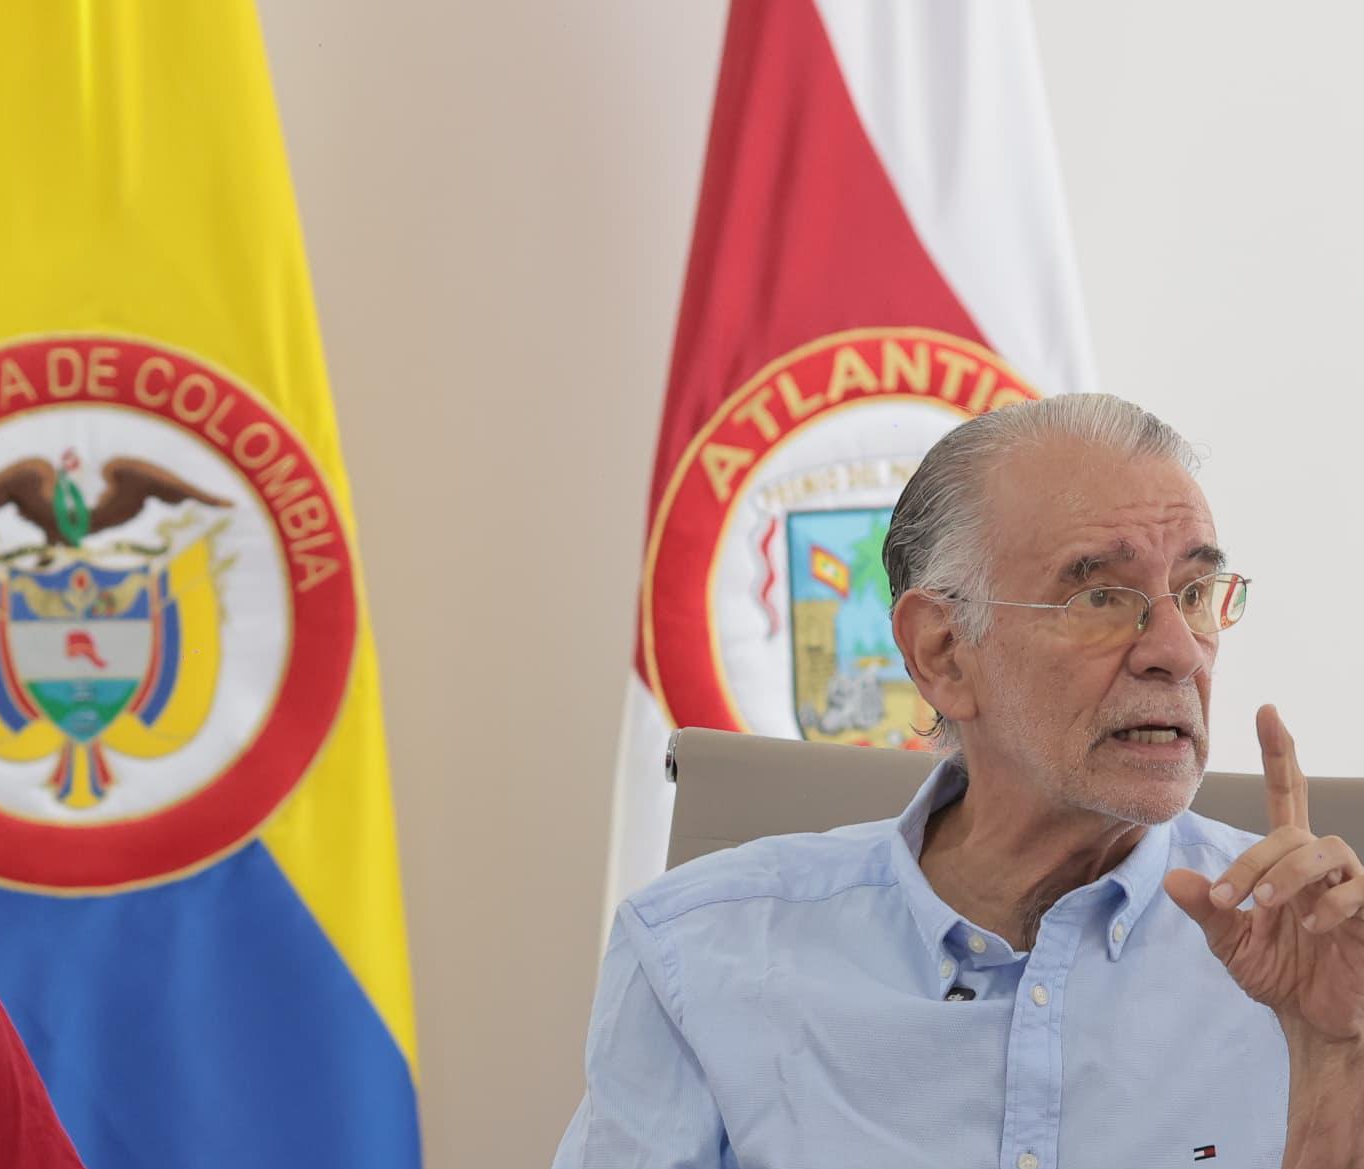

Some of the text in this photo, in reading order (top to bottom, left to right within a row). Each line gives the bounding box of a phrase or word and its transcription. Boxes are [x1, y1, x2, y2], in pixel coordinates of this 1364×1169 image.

[46, 347, 122, 398] DE
[134, 356, 341, 594] COLOMBIA
[699, 340, 1024, 502] ATLANTI
